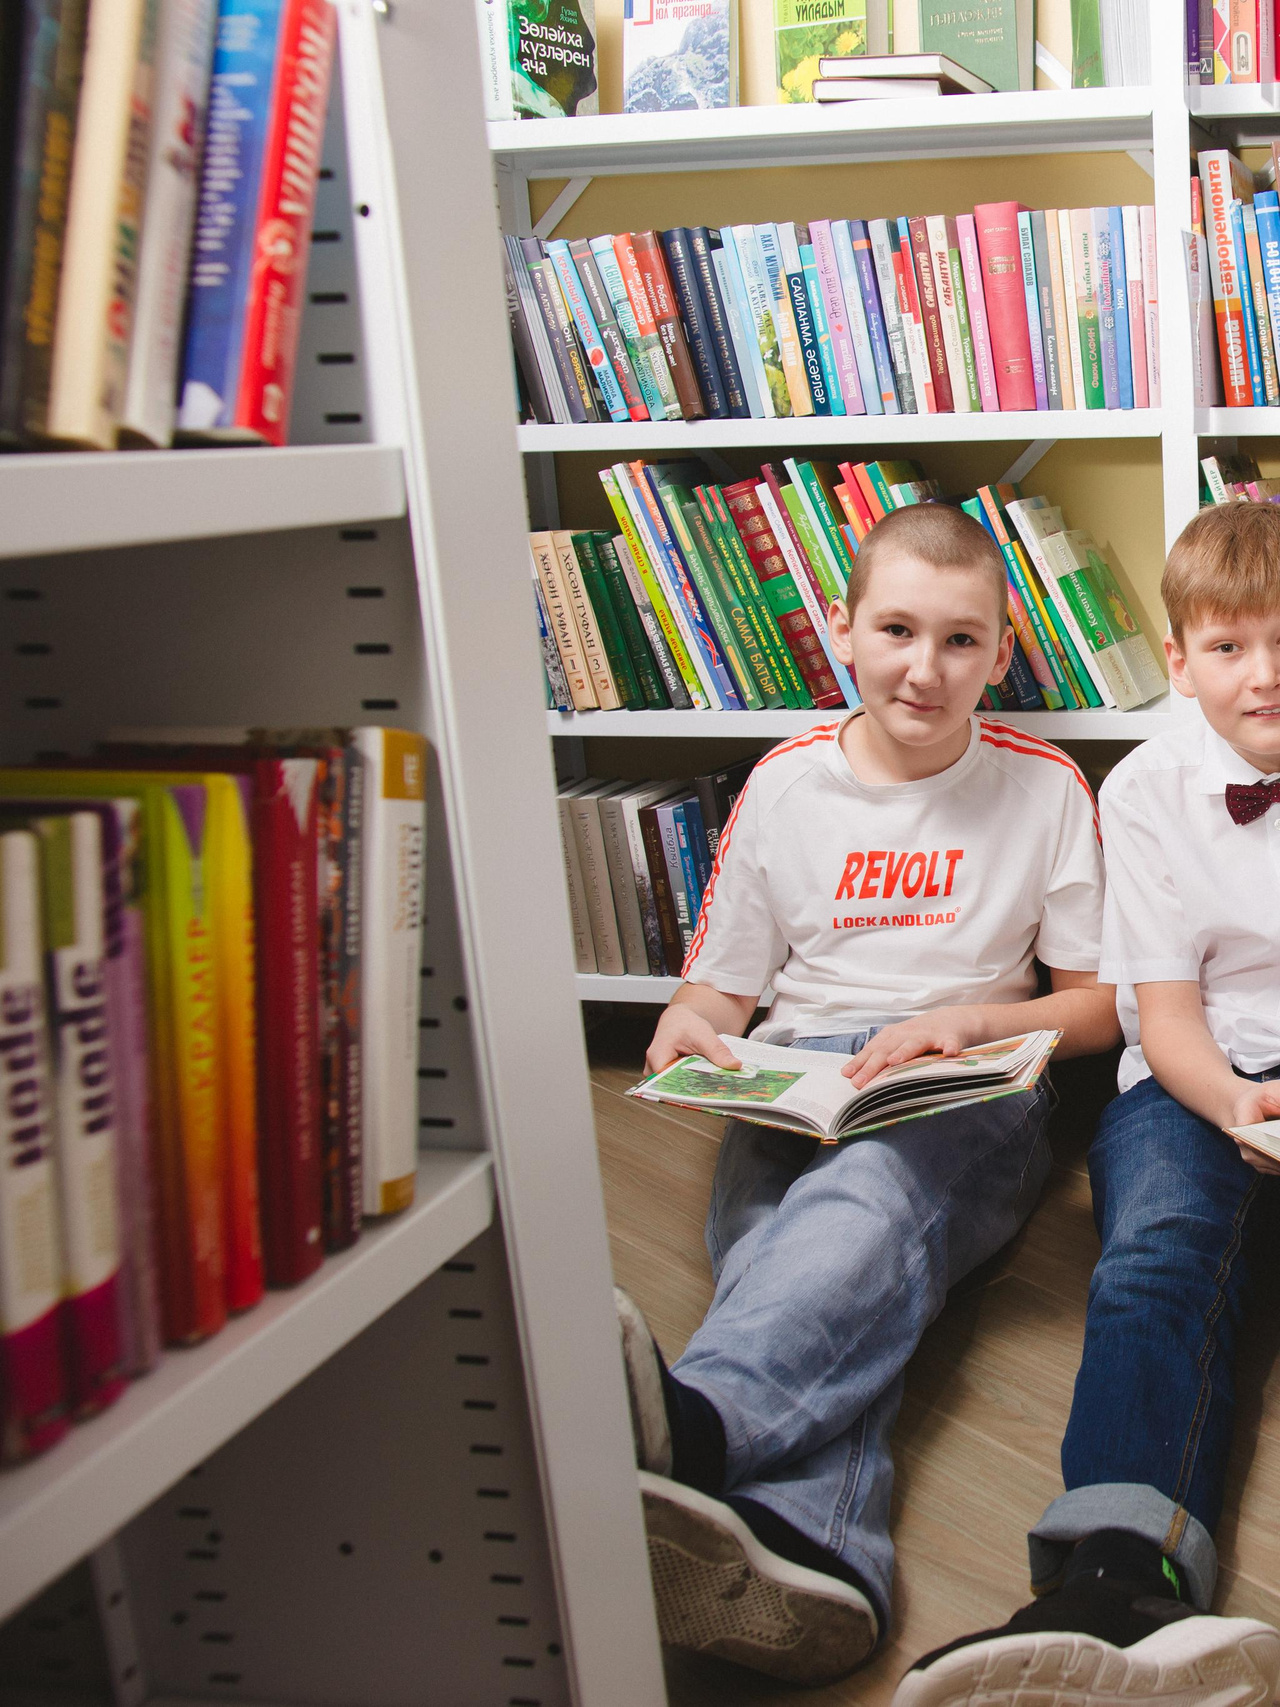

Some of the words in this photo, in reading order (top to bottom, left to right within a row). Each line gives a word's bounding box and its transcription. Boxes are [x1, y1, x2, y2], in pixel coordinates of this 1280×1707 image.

[521, 57, 547, 75] ача
[760, 233, 774, 252] АХАТ
[765, 255, 785, 301] МУШИНСКИЙ
[557, 256, 581, 304] КРАСНЫЙ
[574, 306, 595, 345] ЦВЕТОК
[656, 284, 669, 314] Роберт
[1255, 281, 1264, 317] ДОМИКА
[556, 308, 572, 342] ЛЕРОН
[790, 276, 813, 347] САЙЛАНМА
[806, 349, 826, 404] ӘСӘРЛӘР
[1088, 326, 1098, 360] САФИН
[1259, 319, 1269, 358] ДАЧНОГО
[597, 371, 614, 409] МАЛИКОВА
[603, 369, 617, 399] МАДИНА
[1262, 359, 1275, 401] ИНТЕРЬЕР
[552, 603, 573, 649] ТУФАН
[575, 603, 596, 649] ТУФАН
[643, 612, 669, 667] НЕОБЪЯВЛЕННАЯ
[661, 669, 677, 692] ВОЙНА
[730, 607, 758, 649] САМАТ
[749, 654, 777, 696] БАТЫР
[835, 849, 964, 900] REVOLT
